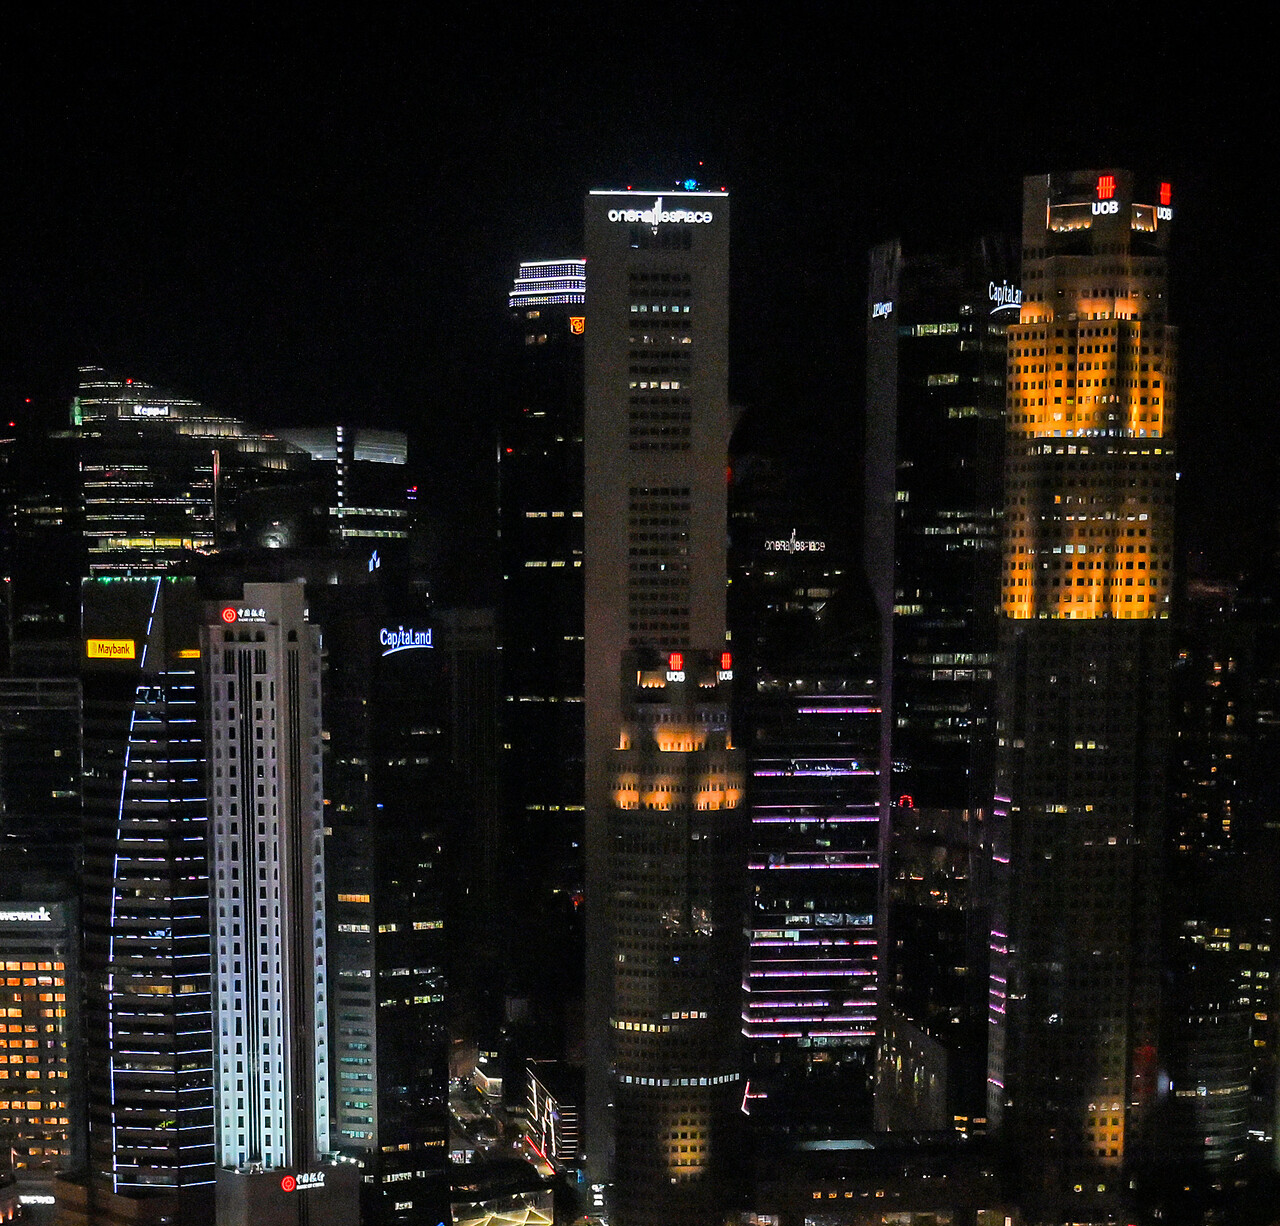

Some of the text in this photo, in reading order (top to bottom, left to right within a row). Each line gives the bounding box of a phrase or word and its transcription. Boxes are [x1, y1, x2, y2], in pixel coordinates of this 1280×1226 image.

[1091, 201, 1119, 215] UOB
[1157, 206, 1173, 221] UOB
[380, 626, 432, 649] CapitaLand
[98, 643, 131, 656] Maybank
[666, 671, 685, 682] UOB
[719, 670, 733, 681] UOB
